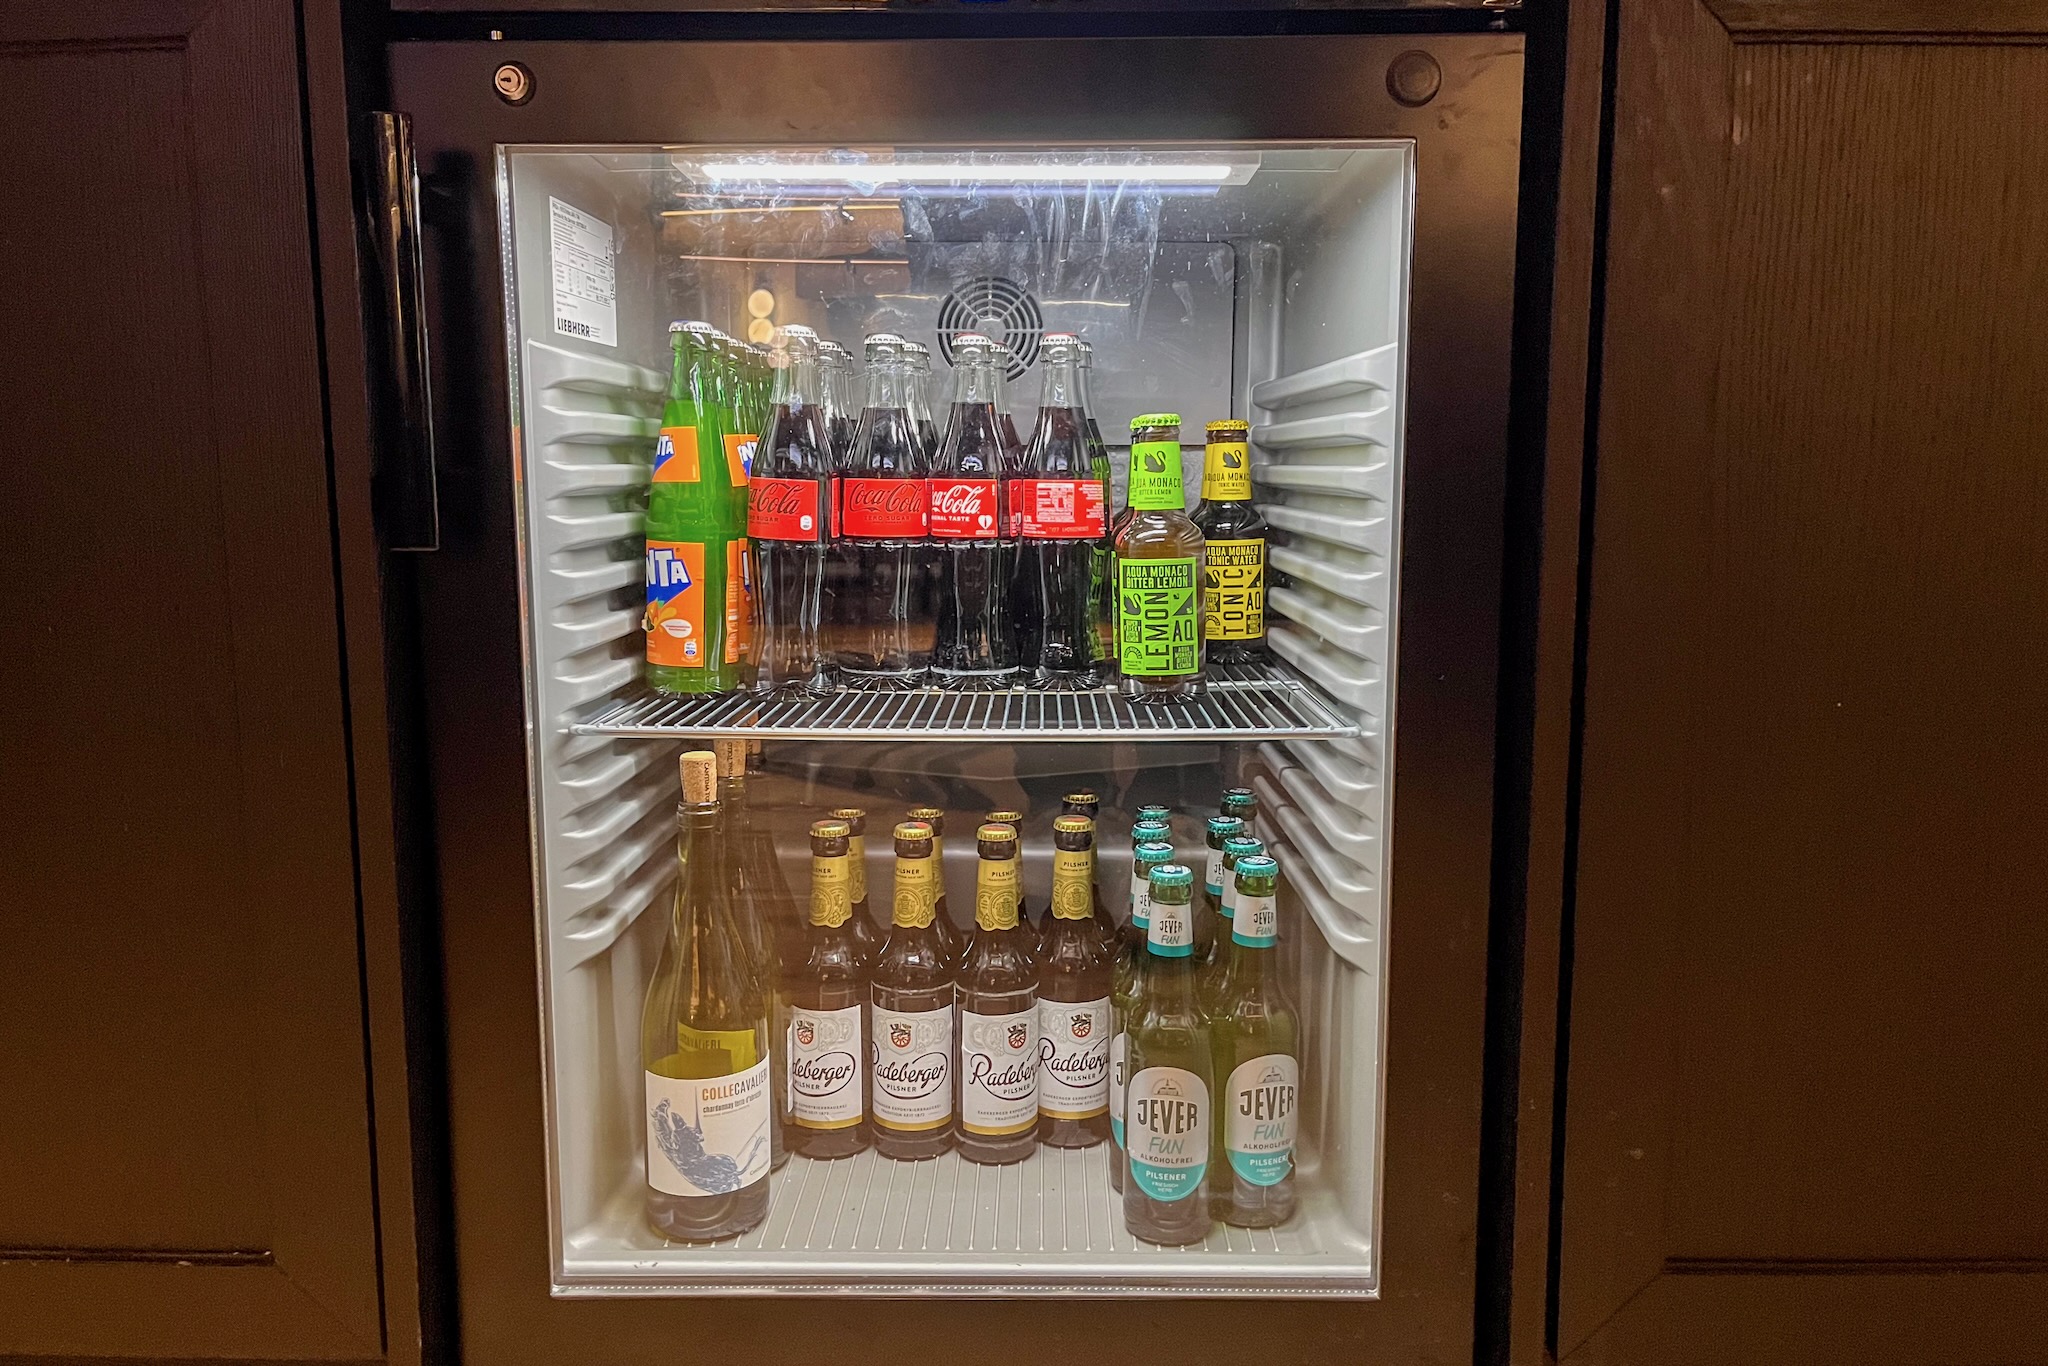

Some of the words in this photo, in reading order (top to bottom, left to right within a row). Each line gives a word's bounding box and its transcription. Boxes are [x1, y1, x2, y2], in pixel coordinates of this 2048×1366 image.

[557, 317, 590, 338] LIEBHERR
[850, 483, 922, 513] Coca-Cola
[1206, 546, 1225, 556] AQUA
[1229, 545, 1259, 555] MONACO
[1208, 556, 1229, 566] TONIC
[1233, 555, 1258, 565] WATER
[1126, 565, 1147, 578] AQUA
[1150, 564, 1188, 577] MONACO
[1126, 577, 1154, 589] BITTER
[1157, 577, 1188, 588] LEMON
[1222, 568, 1244, 636] TONIC
[1144, 592, 1170, 671] LEMON
[1253, 911, 1274, 925] JEVER
[1159, 920, 1183, 935] JEVER
[1255, 926, 1273, 936] FUN
[1161, 935, 1180, 945] FUN
[1066, 1073, 1096, 1081] PILSNER
[886, 1083, 917, 1092] PILSNER
[1003, 1084, 1030, 1094] PILSNER
[1240, 1085, 1295, 1121] JEVER
[1137, 1099, 1198, 1134] JEVER
[1253, 1122, 1286, 1141] FUN
[1149, 1136, 1185, 1155] FUN
[1140, 1153, 1193, 1163] ALKOHOLFREI
[1145, 1170, 1187, 1181] PILSENER
